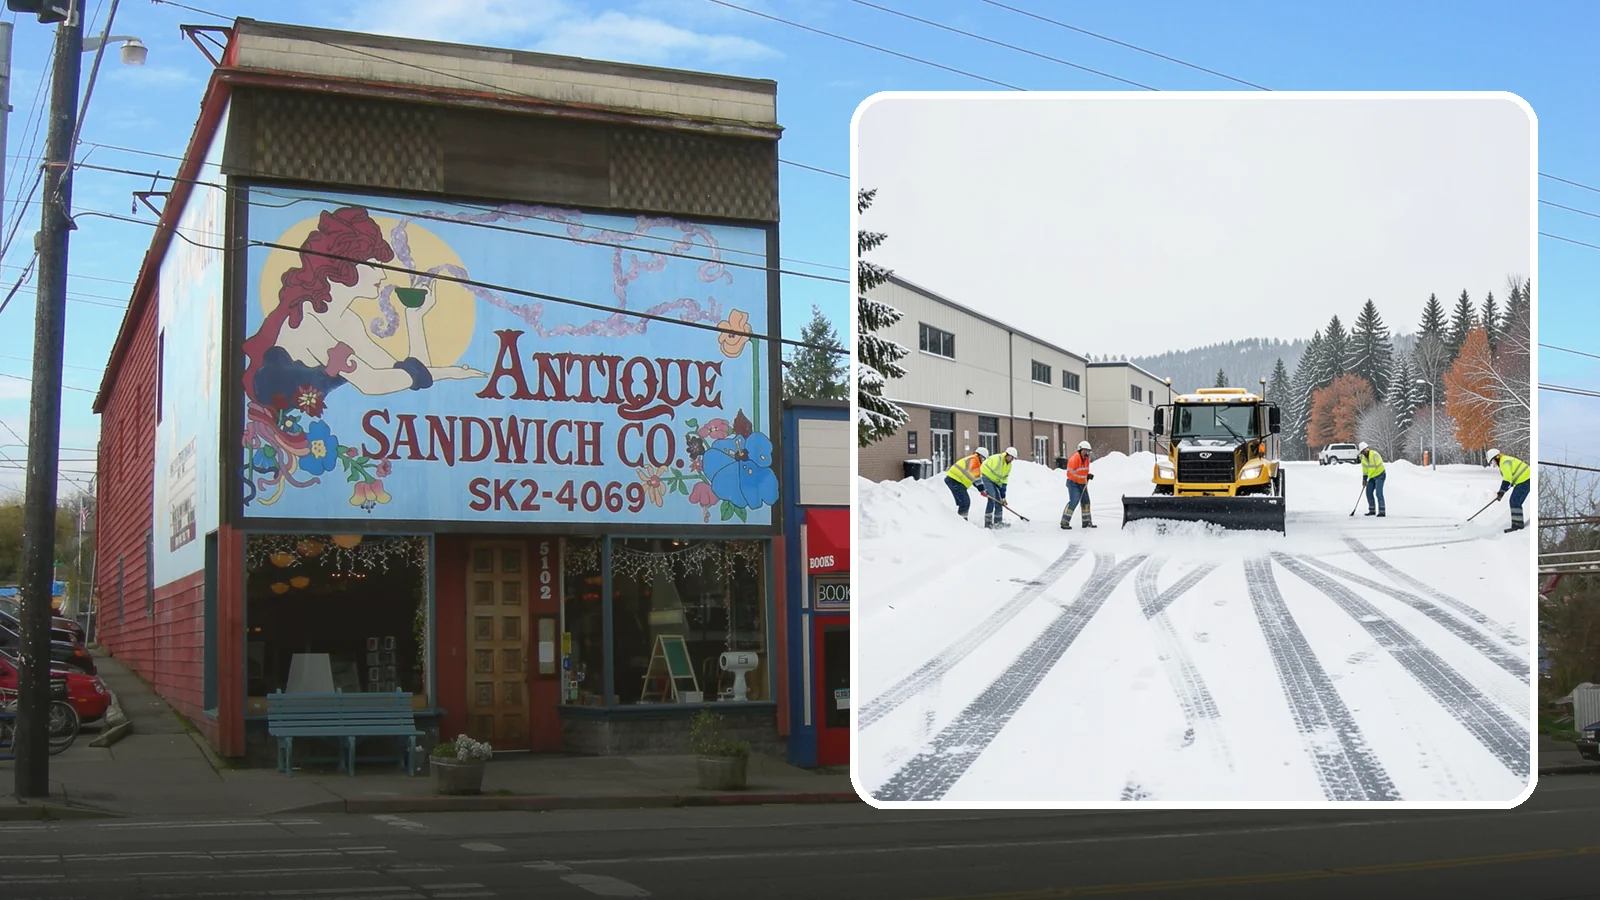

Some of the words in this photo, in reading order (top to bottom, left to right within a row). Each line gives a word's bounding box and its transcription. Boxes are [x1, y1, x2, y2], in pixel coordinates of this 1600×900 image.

[476, 329, 723, 421] ANTIQUE
[361, 408, 604, 467] SANDWICH
[617, 422, 685, 468] CO.
[468, 477, 646, 513] SK2-4069
[540, 541, 552, 600] 5102
[809, 555, 835, 569] BOOKS
